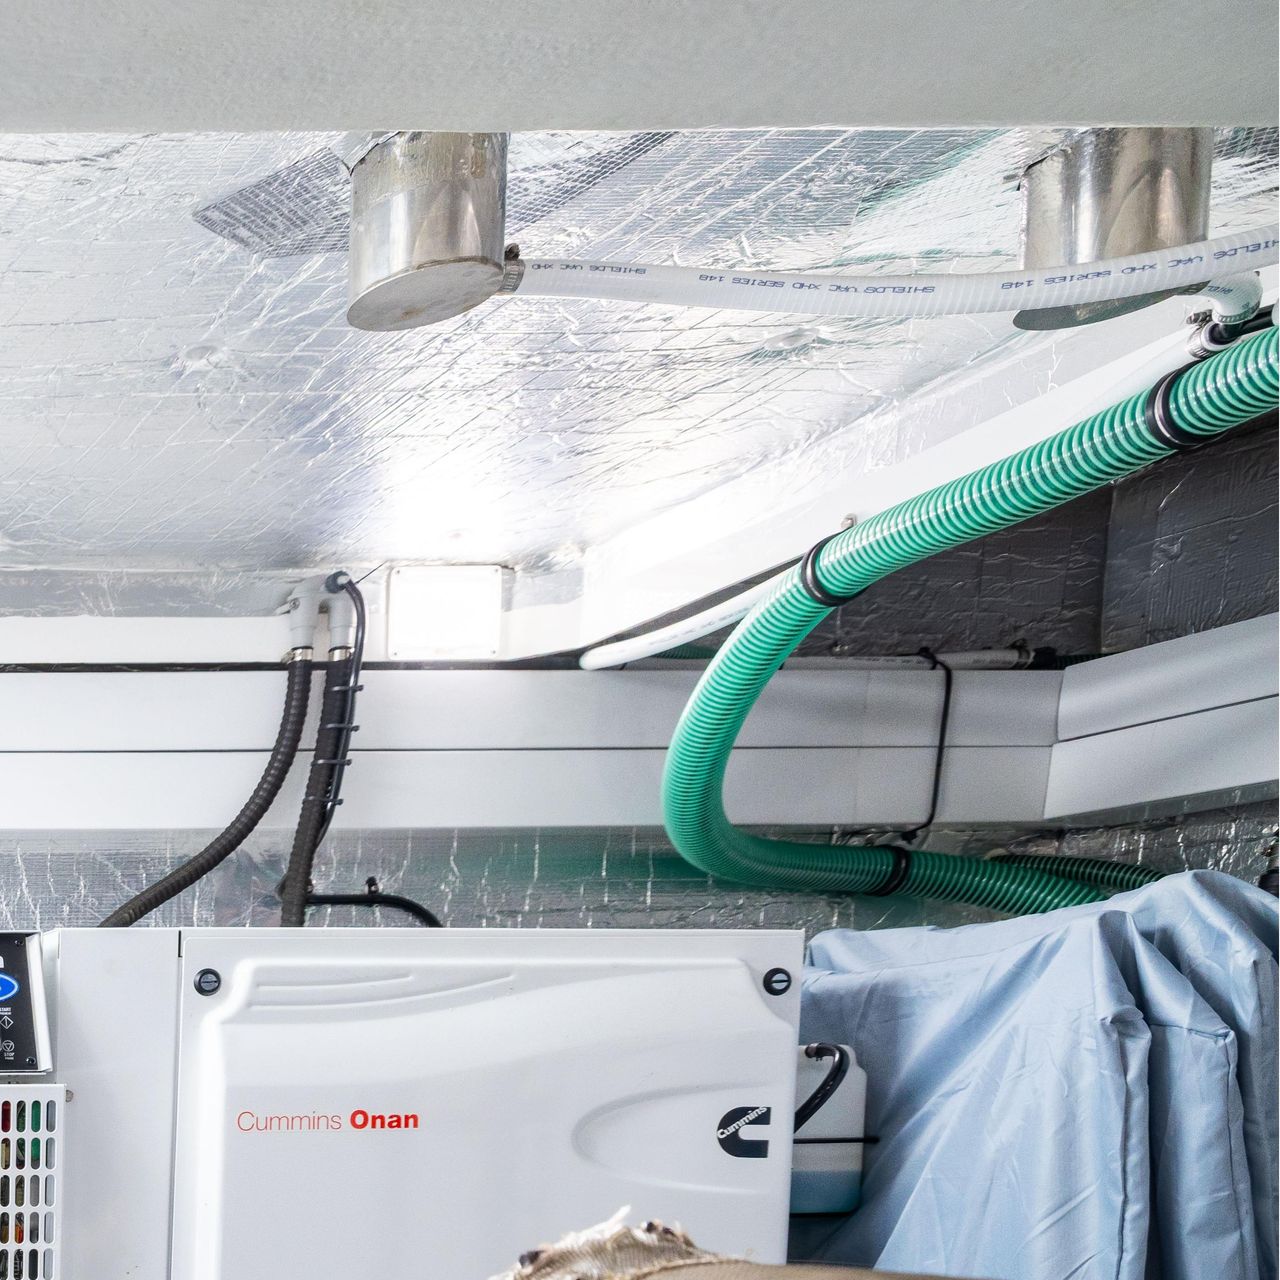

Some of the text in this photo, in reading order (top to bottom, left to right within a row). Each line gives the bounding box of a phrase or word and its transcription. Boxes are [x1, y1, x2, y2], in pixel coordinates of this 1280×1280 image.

[590, 264, 646, 275] SHIELDS
[1001, 239, 1279, 290] HIELDS VAC XHD SERIES 148
[698, 273, 935, 294] SHIELDS VAC XHD SERIES 148
[237, 1109, 419, 1131] Cummins Onan
[717, 1107, 767, 1139] Cummins
